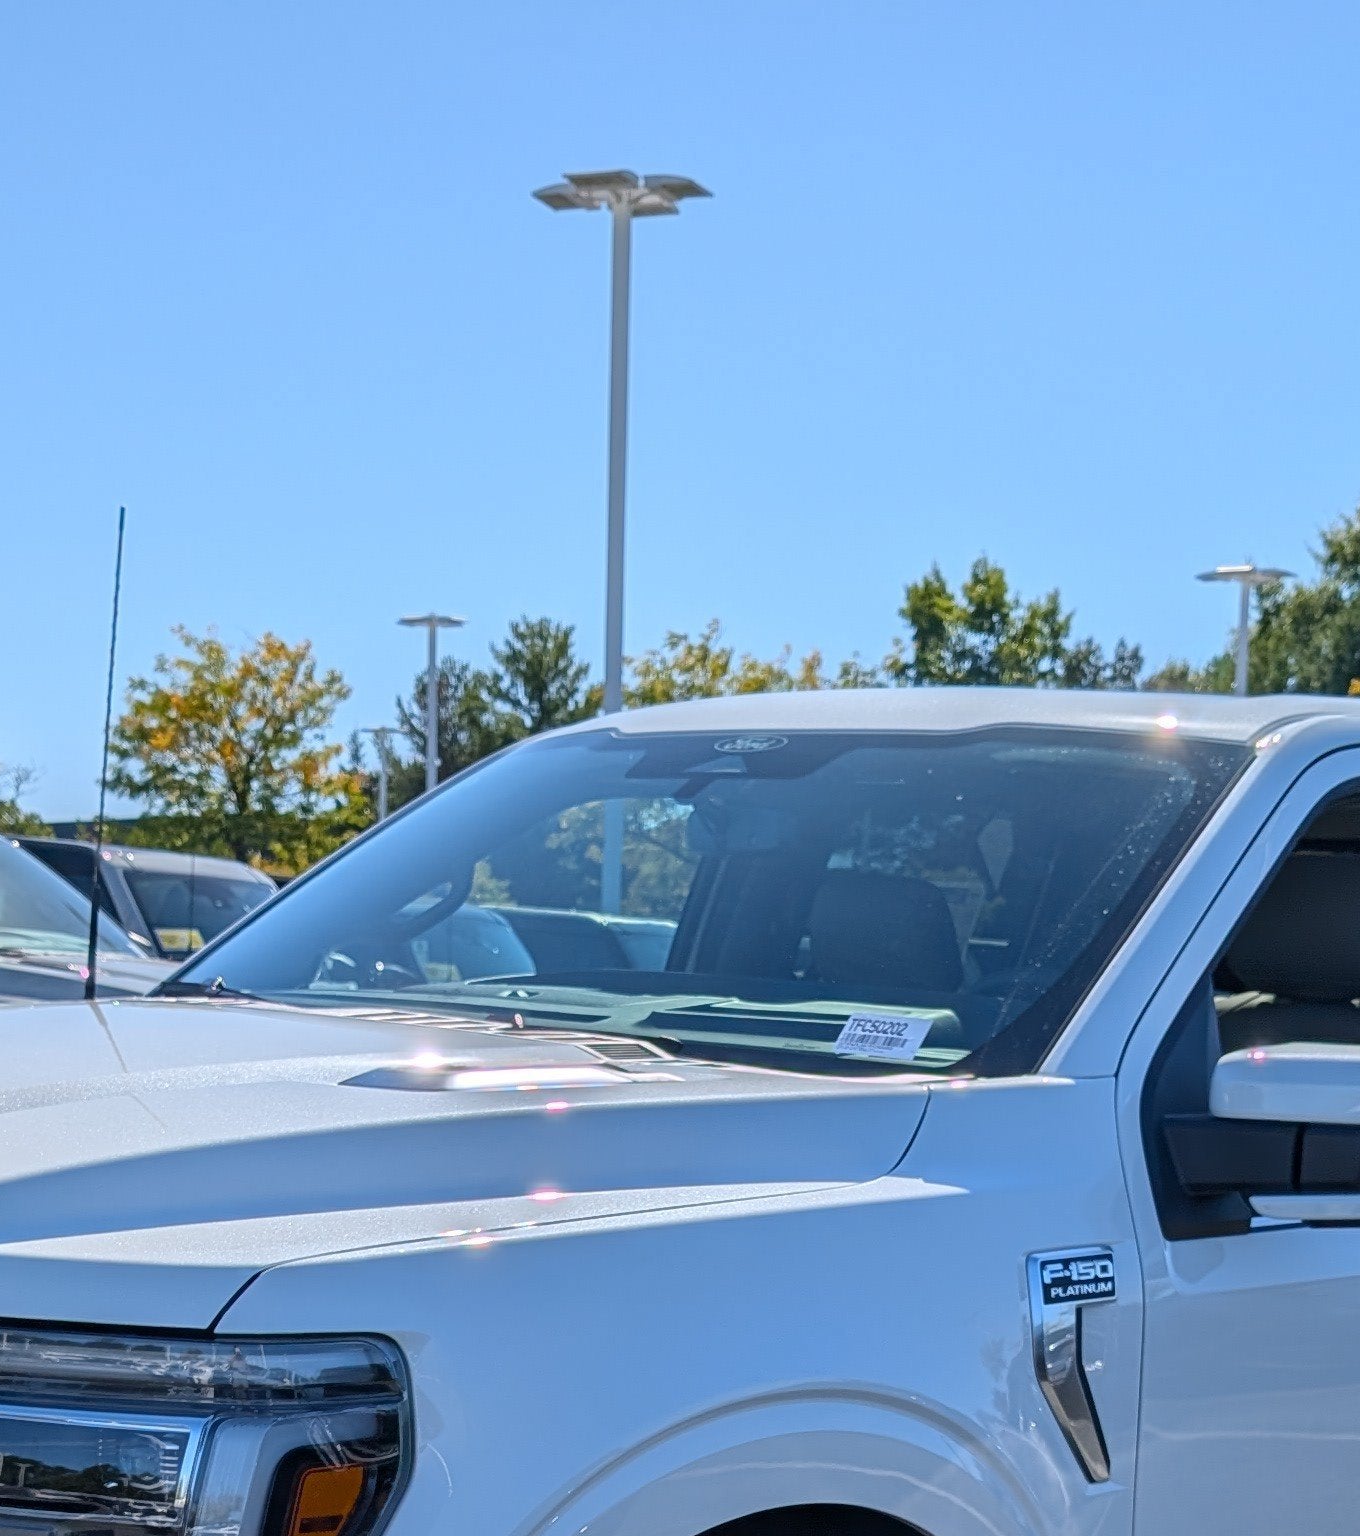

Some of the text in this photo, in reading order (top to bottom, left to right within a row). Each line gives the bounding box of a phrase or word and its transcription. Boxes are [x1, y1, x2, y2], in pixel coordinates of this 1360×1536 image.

[848, 1018, 909, 1036] TFC50202
[1042, 1259, 1114, 1285] F-150
[1050, 1281, 1113, 1299] PLATINUM
